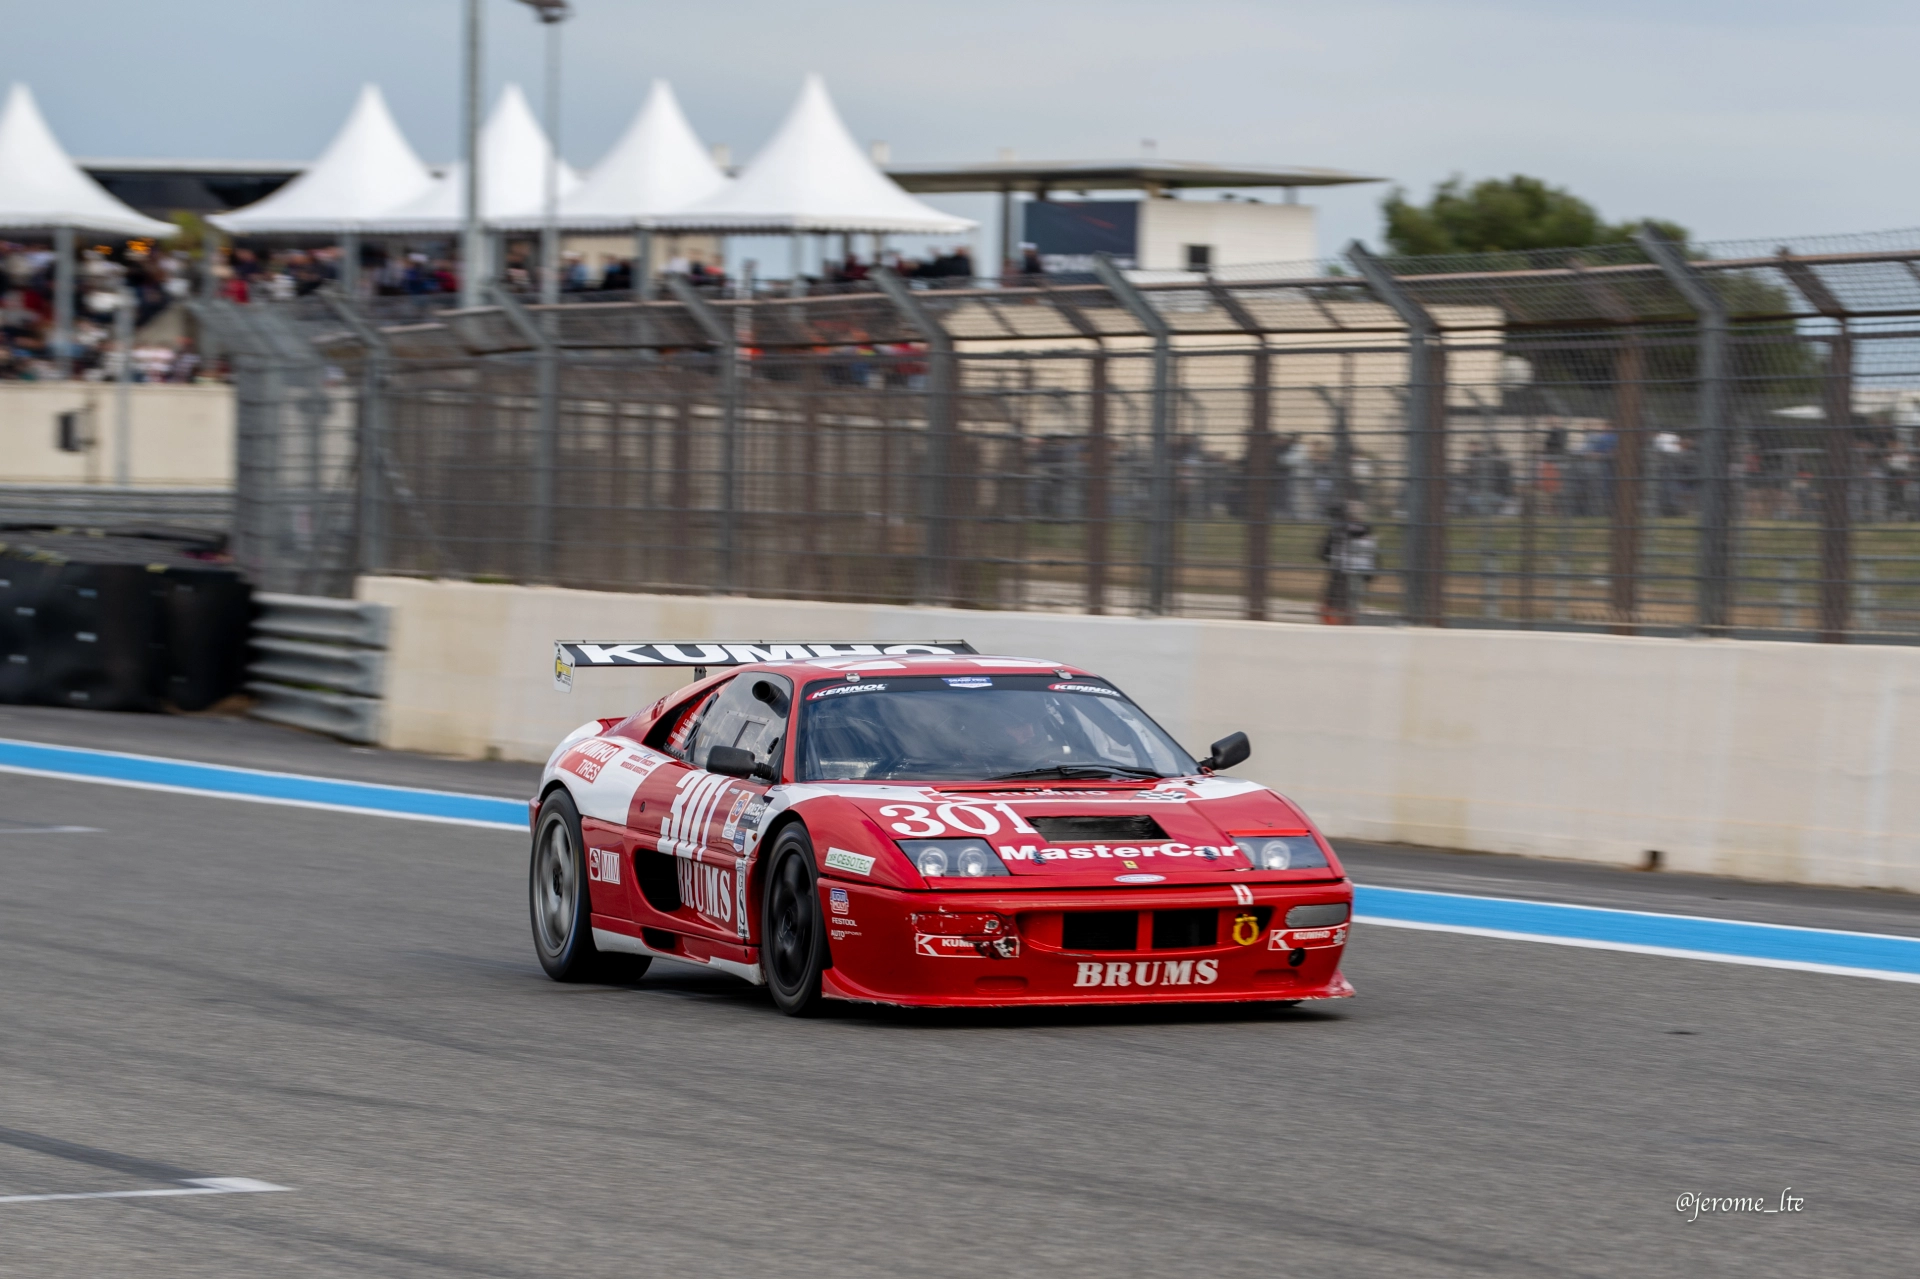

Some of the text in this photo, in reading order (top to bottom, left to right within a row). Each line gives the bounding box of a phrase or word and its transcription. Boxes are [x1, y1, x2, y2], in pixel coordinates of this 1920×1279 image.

[812, 684, 886, 699] KENNOL
[1054, 685, 1121, 697] KENNOL
[575, 759, 601, 781] TIRES
[657, 771, 740, 862] 301
[879, 802, 1038, 838] 301
[837, 854, 870, 870] CESOTEC
[677, 857, 732, 923] BRUMS
[831, 917, 858, 927] FESTOOL
[1073, 959, 1219, 987] BRUMS
